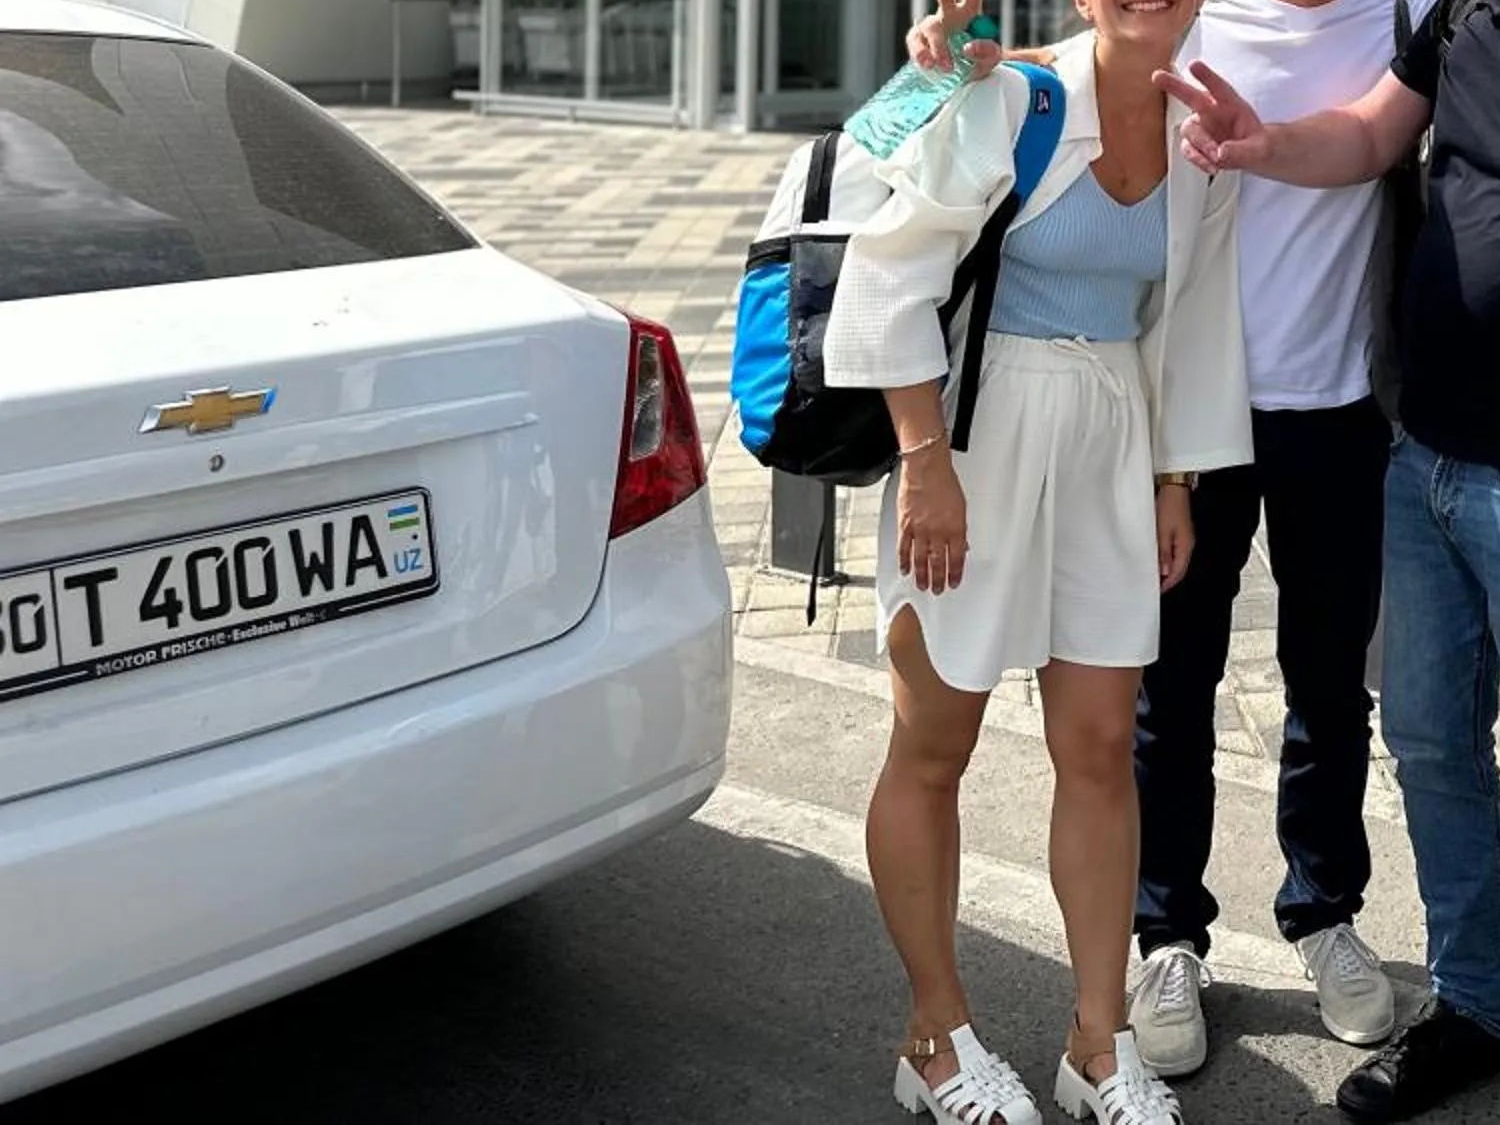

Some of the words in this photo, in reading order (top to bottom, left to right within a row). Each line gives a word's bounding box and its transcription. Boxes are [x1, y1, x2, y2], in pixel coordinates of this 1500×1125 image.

[63, 567, 119, 648] T
[139, 536, 279, 630] 400
[288, 514, 389, 598] WA
[393, 548, 424, 573] UZ
[96, 650, 157, 676] MOTOR
[161, 632, 226, 660] FRISCHE
